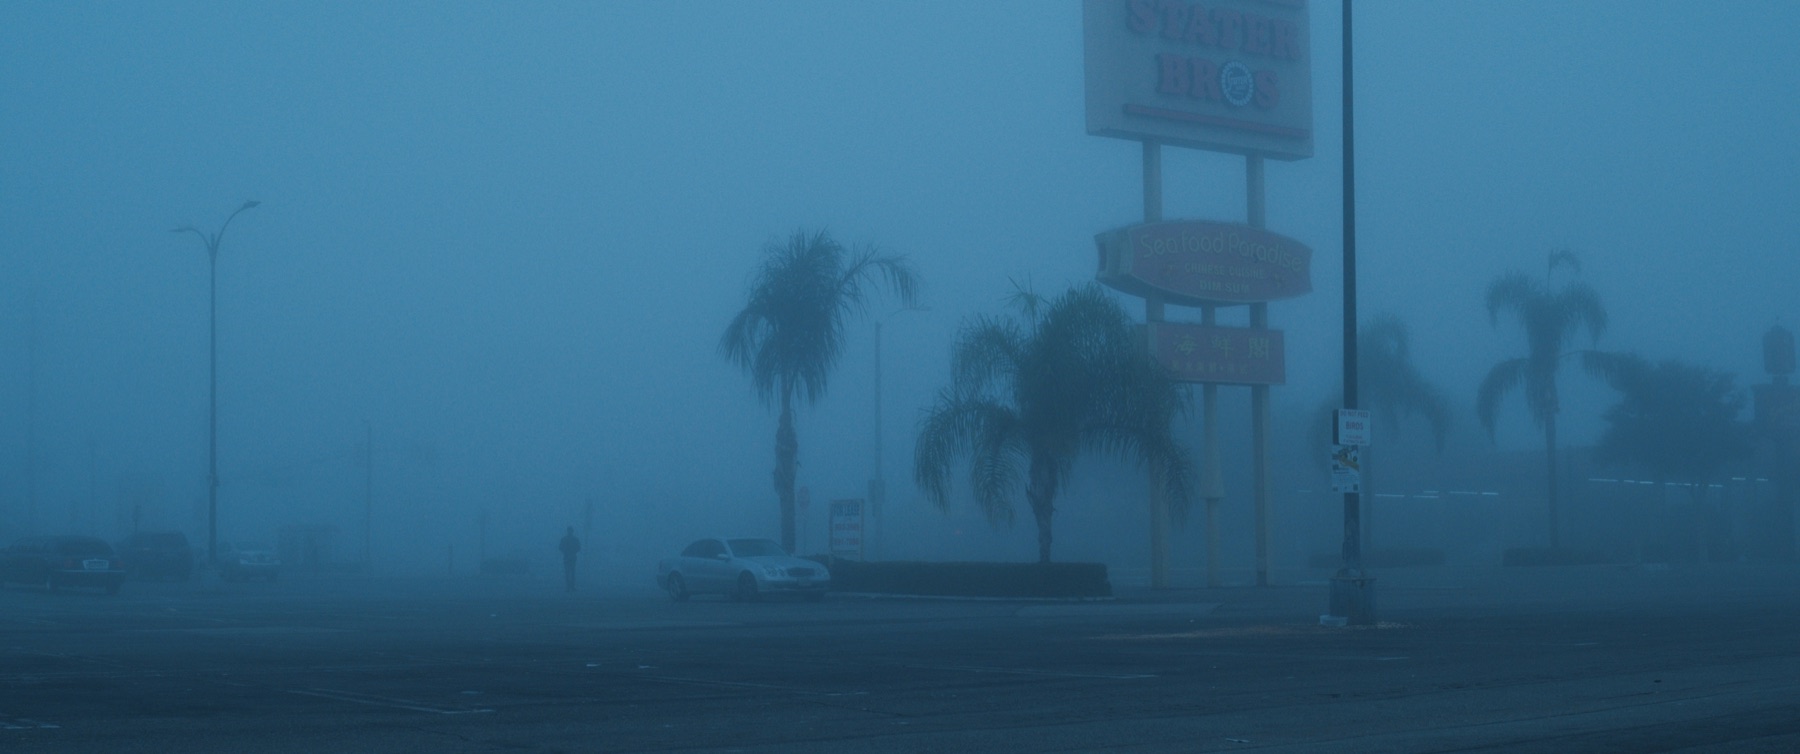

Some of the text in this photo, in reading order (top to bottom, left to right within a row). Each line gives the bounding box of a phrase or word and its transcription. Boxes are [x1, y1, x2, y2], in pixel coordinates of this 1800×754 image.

[1128, 0, 1301, 60] STATER
[1140, 230, 1303, 272] Seafood Paradise
[1184, 263, 1265, 280] CHINESE CUISINE
[1200, 281, 1250, 293] DIM SUM
